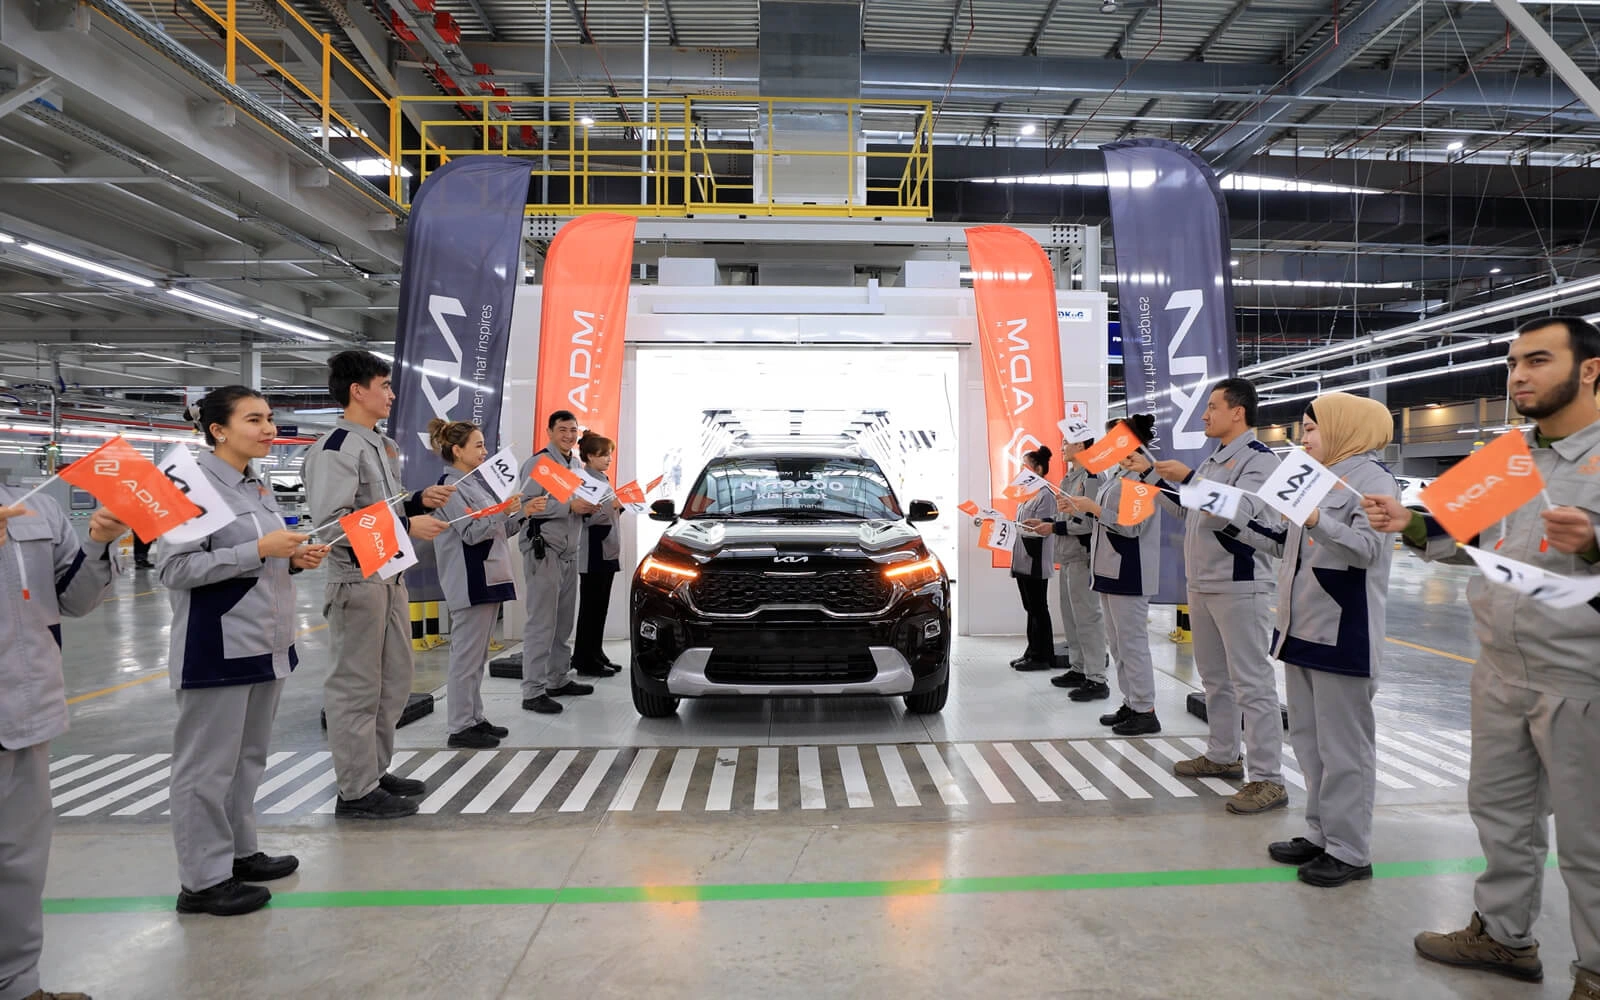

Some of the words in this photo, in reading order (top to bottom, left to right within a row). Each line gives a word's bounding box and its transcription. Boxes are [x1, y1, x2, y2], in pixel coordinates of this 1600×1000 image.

[477, 304, 493, 352] inspires
[472, 355, 487, 381] that
[568, 309, 595, 413] ADM
[122, 479, 169, 518] ADM
[371, 531, 389, 561] ADM
